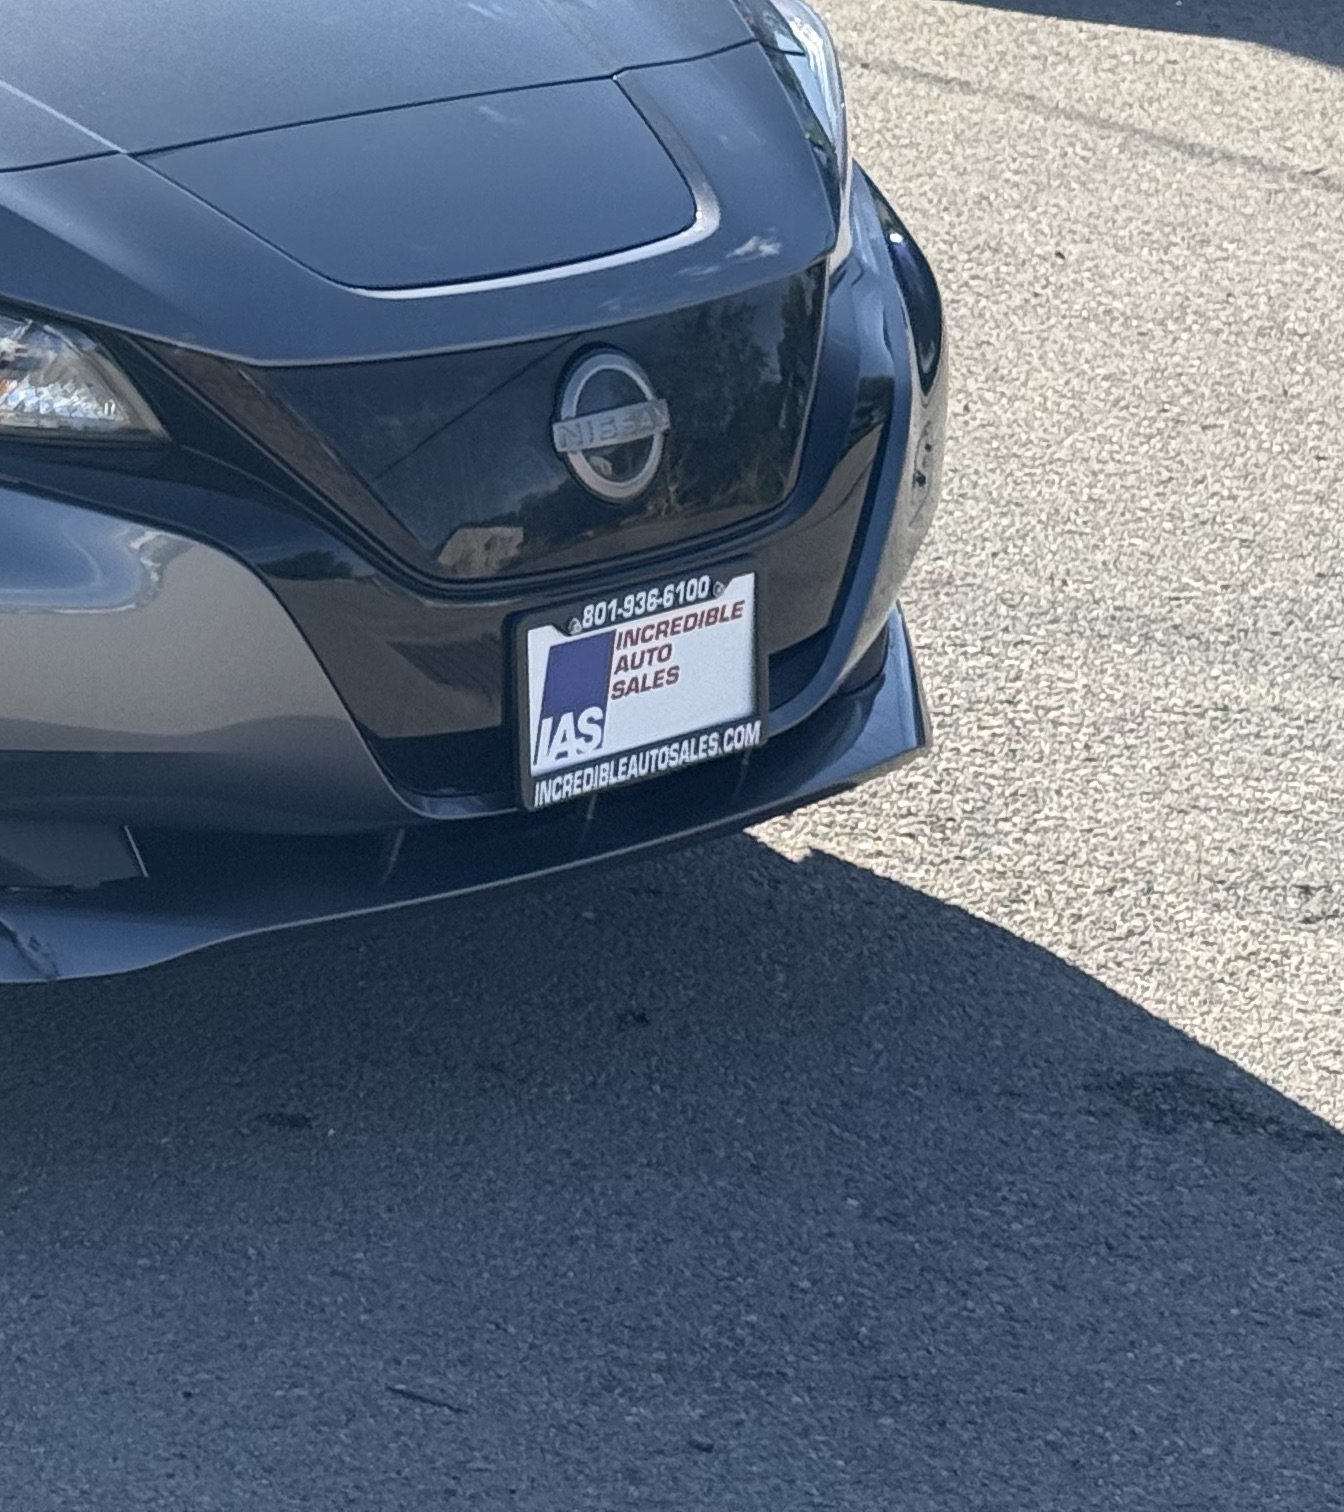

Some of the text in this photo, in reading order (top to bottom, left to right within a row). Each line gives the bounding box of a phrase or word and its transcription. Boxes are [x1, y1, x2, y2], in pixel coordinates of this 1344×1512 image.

[582, 575, 710, 628] 801-936-6100
[616, 600, 745, 650] INCREDIBLE
[610, 665, 680, 700] SALES
[614, 643, 673, 676] AUTO
[533, 706, 604, 768] IAS
[534, 720, 761, 807] INCREDIBLEAUTOSALES.COM
